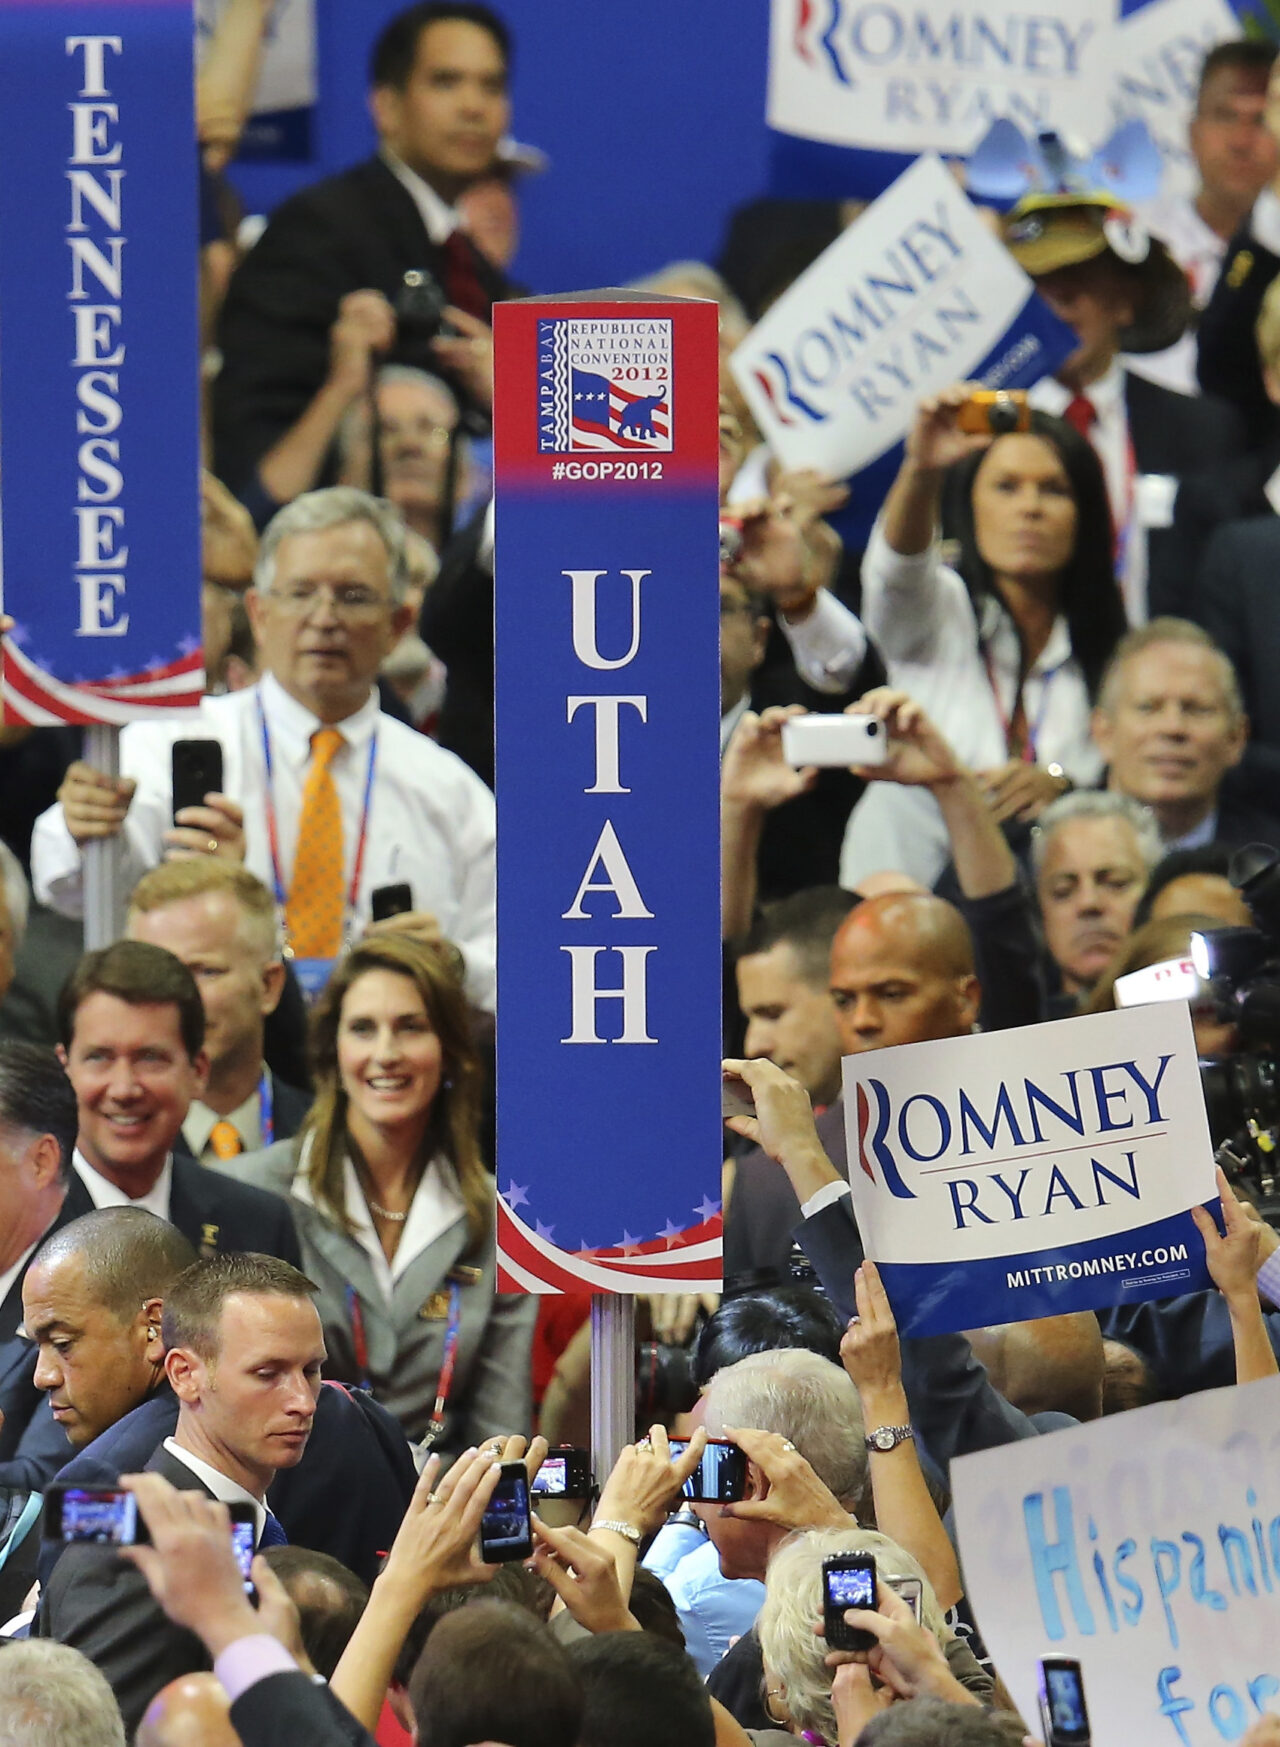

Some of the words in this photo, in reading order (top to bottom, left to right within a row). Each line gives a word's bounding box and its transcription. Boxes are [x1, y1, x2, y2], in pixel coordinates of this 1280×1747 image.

[66, 35, 129, 637] TENNESSEE
[541, 322, 554, 363] BAY
[571, 323, 669, 335] REPUBLICAN
[754, 198, 964, 426] ROMNEY
[571, 338, 669, 350] NATIONAL
[571, 353, 669, 365] CONVENTION
[611, 367, 669, 381] 2012
[849, 286, 980, 422] RYAN
[541, 370, 554, 450] TAMPA
[552, 462, 663, 480] #GOP2012
[560, 569, 659, 1044] UTAH
[856, 1054, 1176, 1198] ROMNEY
[944, 1151, 1140, 1230] RYAN
[1006, 1244, 1189, 1289] MITTROMNEY.COM
